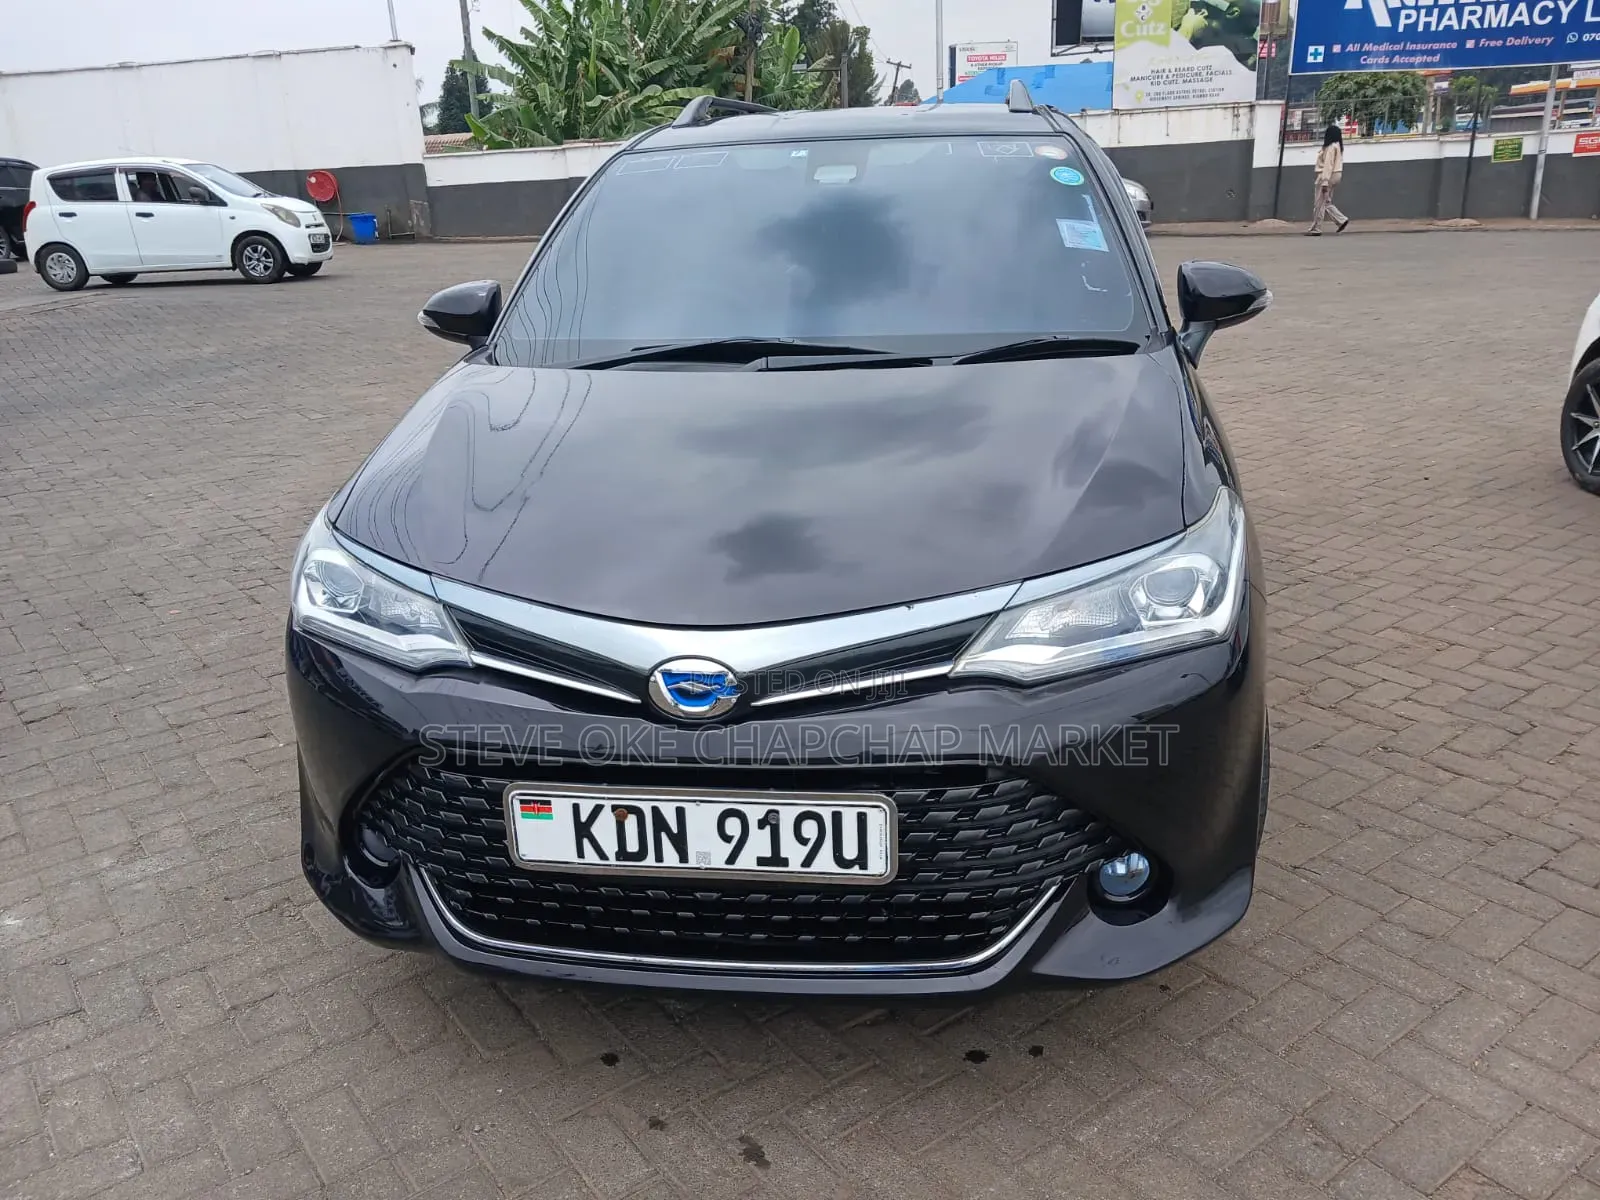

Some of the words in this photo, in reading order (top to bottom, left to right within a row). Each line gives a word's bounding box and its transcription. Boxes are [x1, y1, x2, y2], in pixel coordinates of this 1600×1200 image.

[1397, 0, 1578, 32] PHARMACY
[1120, 20, 1168, 38] Cutz
[1345, 43, 1361, 52] All
[1361, 42, 1403, 52] Medical
[1405, 41, 1458, 51] Insurance
[1479, 38, 1505, 47] Free
[1505, 35, 1555, 46] Delivery
[1360, 55, 1389, 64] Cards
[1390, 53, 1441, 65] Accepted
[1579, 136, 1600, 145] SG
[572, 802, 689, 864] KDN
[716, 807, 869, 871] 919U
